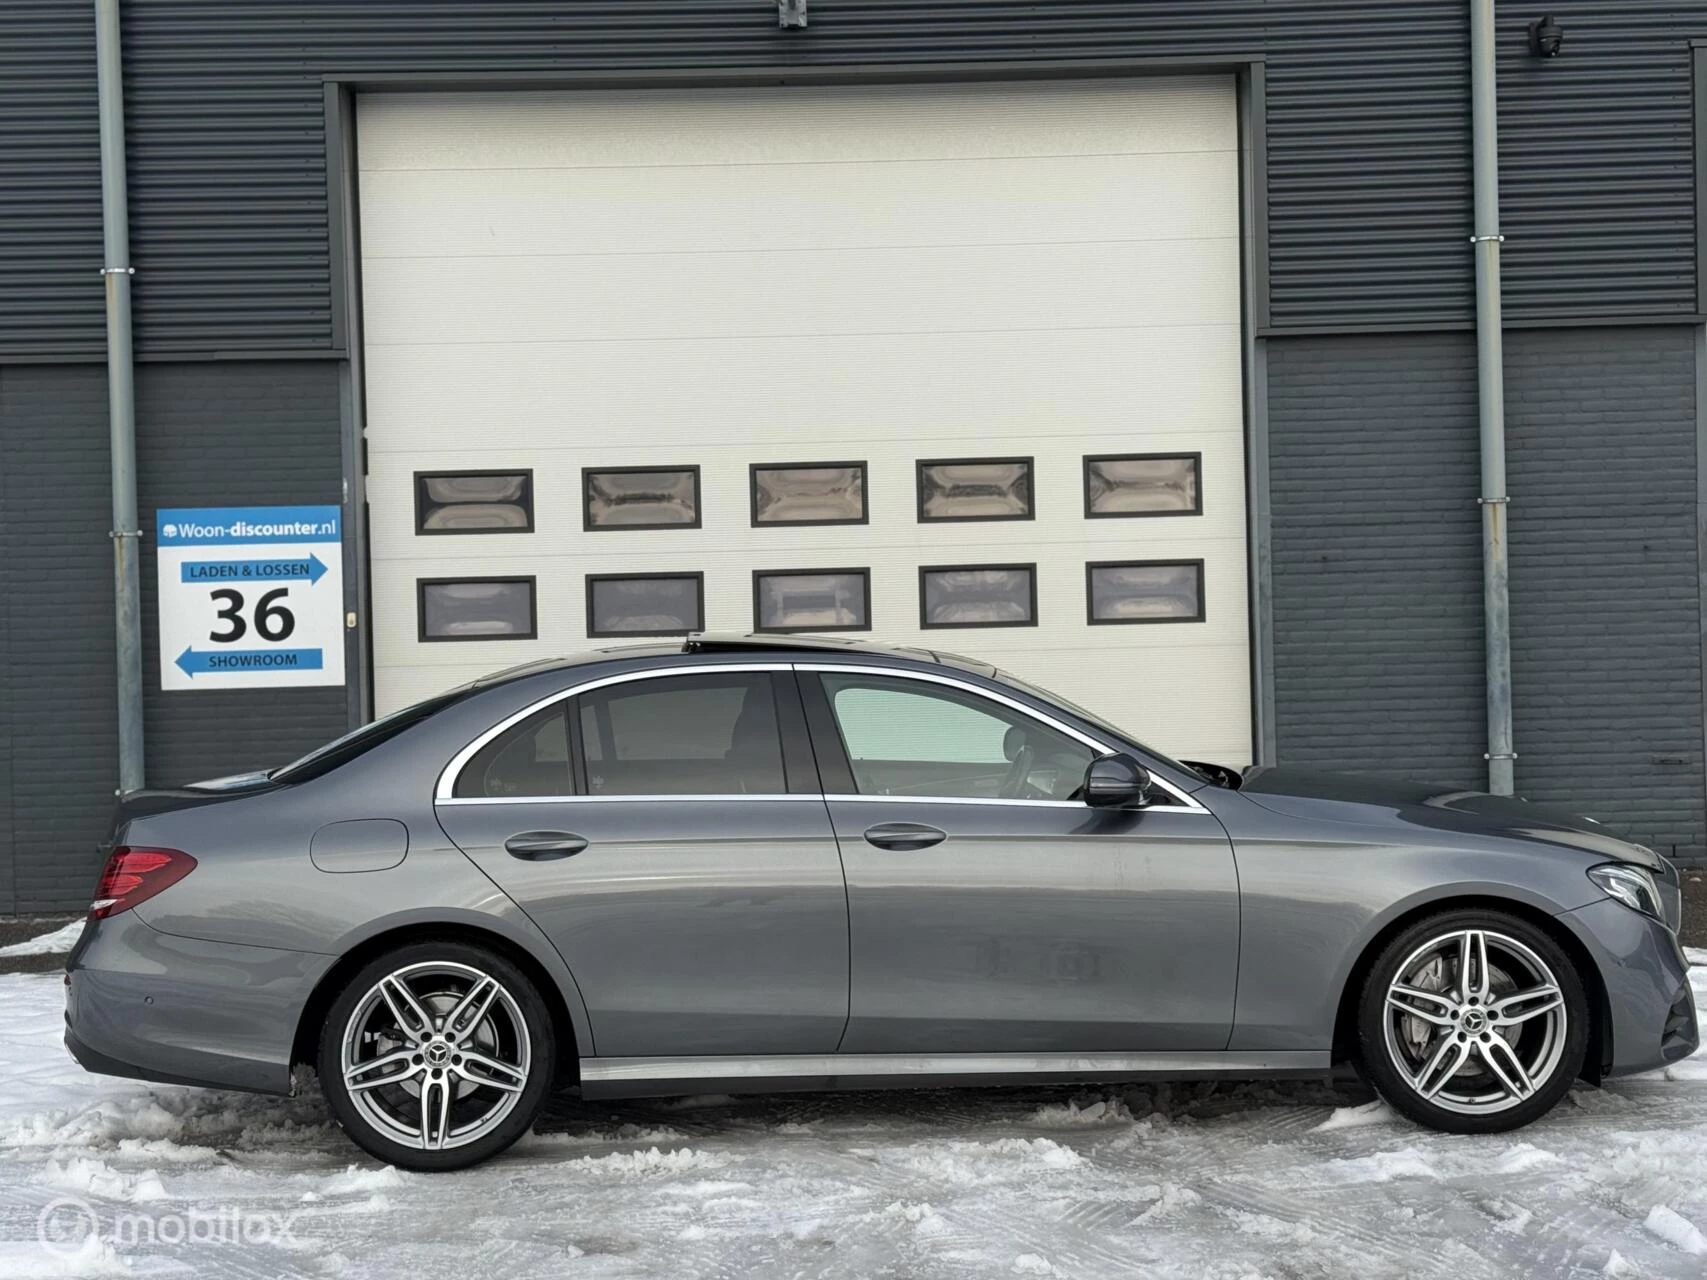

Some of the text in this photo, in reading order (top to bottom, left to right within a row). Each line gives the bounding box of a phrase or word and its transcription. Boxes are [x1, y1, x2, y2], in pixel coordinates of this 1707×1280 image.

[178, 520, 336, 538] Woon-discounter.nl
[190, 563, 310, 578] LADEN & LOSSEN
[209, 587, 295, 643] 36
[209, 654, 298, 668] SHOWROOM
